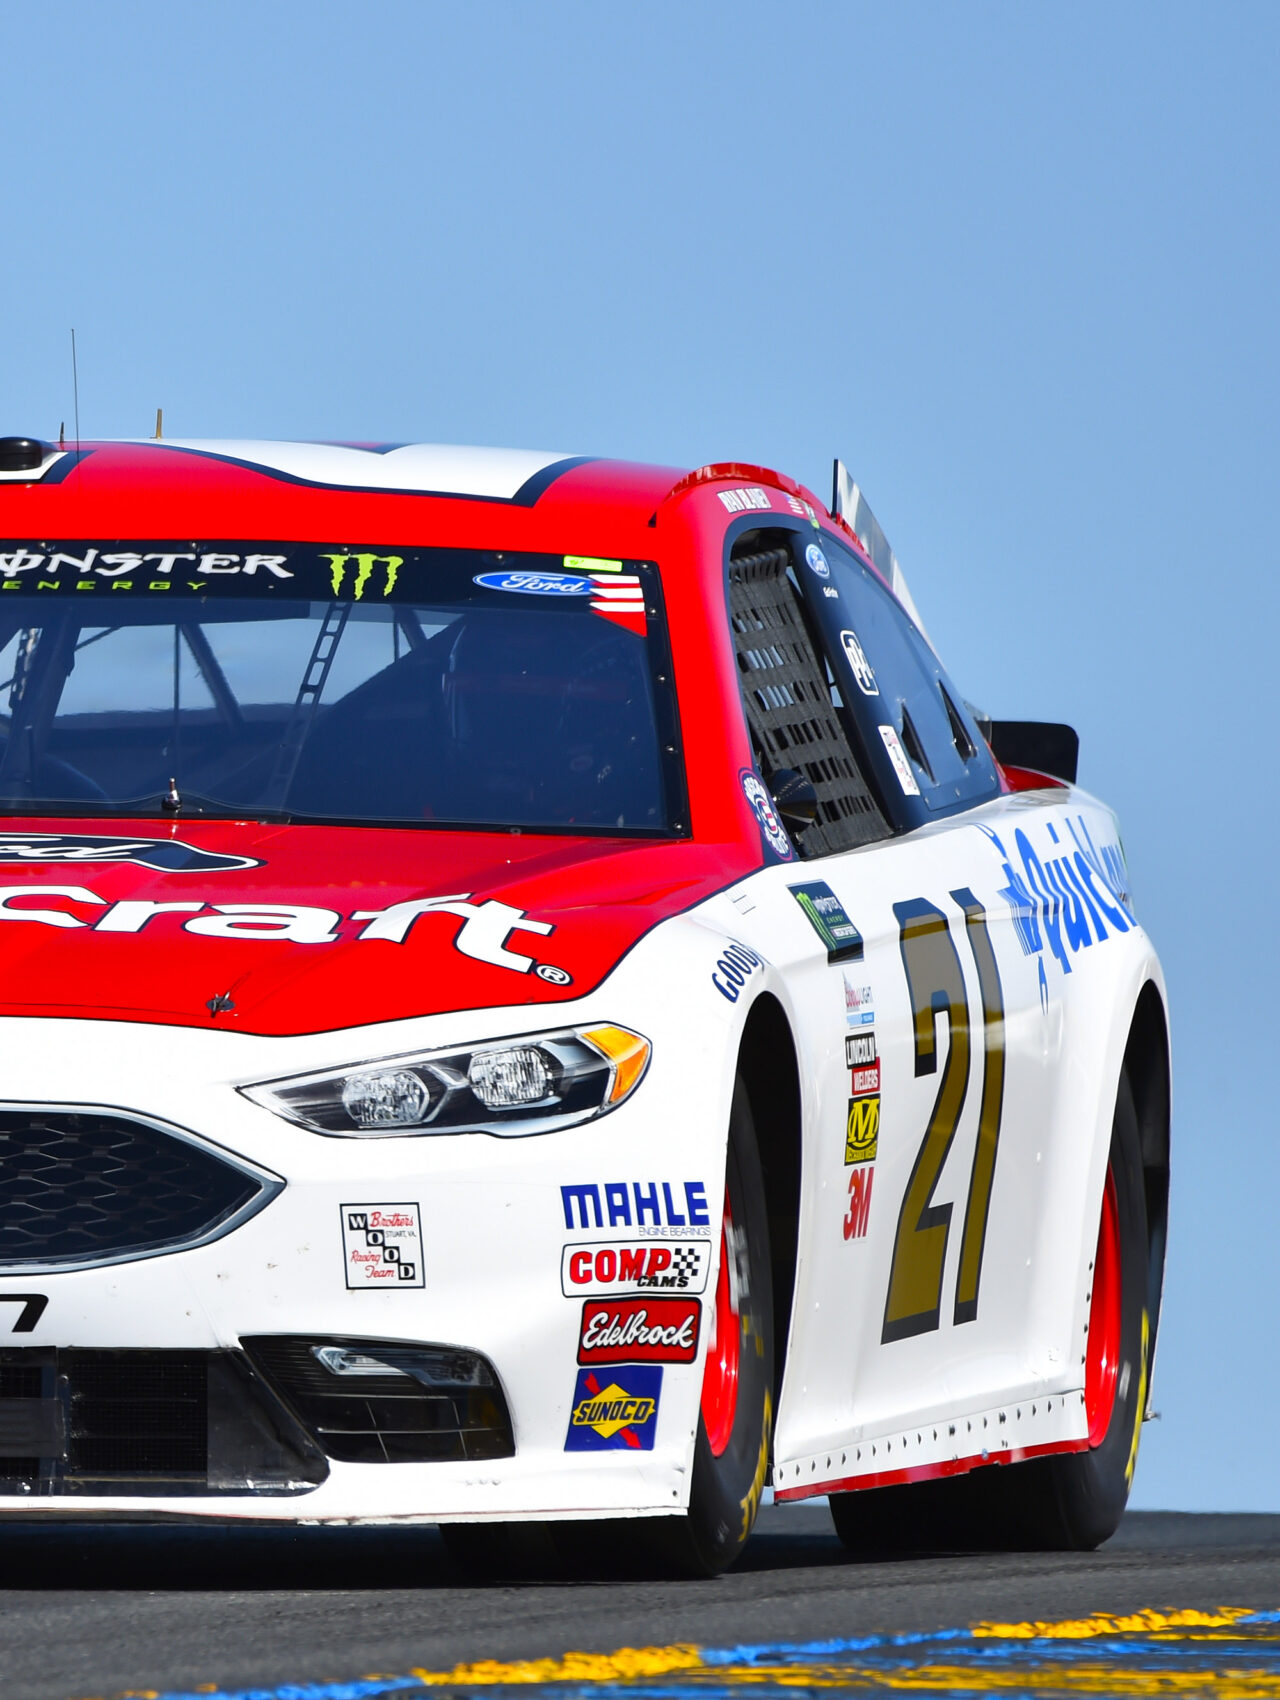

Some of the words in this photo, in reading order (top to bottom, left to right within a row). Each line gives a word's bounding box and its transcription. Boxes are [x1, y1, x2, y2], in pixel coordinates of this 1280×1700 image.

[1, 580, 207, 590] ENERGY
[502, 573, 586, 594] Ford
[880, 886, 1005, 1345] 21
[560, 1182, 710, 1229] MAHLE
[843, 1167, 875, 1241] 3M
[369, 1211, 414, 1228] Brothers
[639, 1227, 669, 1236] ENGINE
[670, 1227, 712, 1236] BEARINGS
[350, 1249, 381, 1265] Racing
[569, 1248, 672, 1285] COMP
[365, 1265, 395, 1279] Team
[637, 1275, 689, 1288] CAMS
[582, 1310, 696, 1349] Edelbrock
[575, 1401, 650, 1423] SUNOCO
